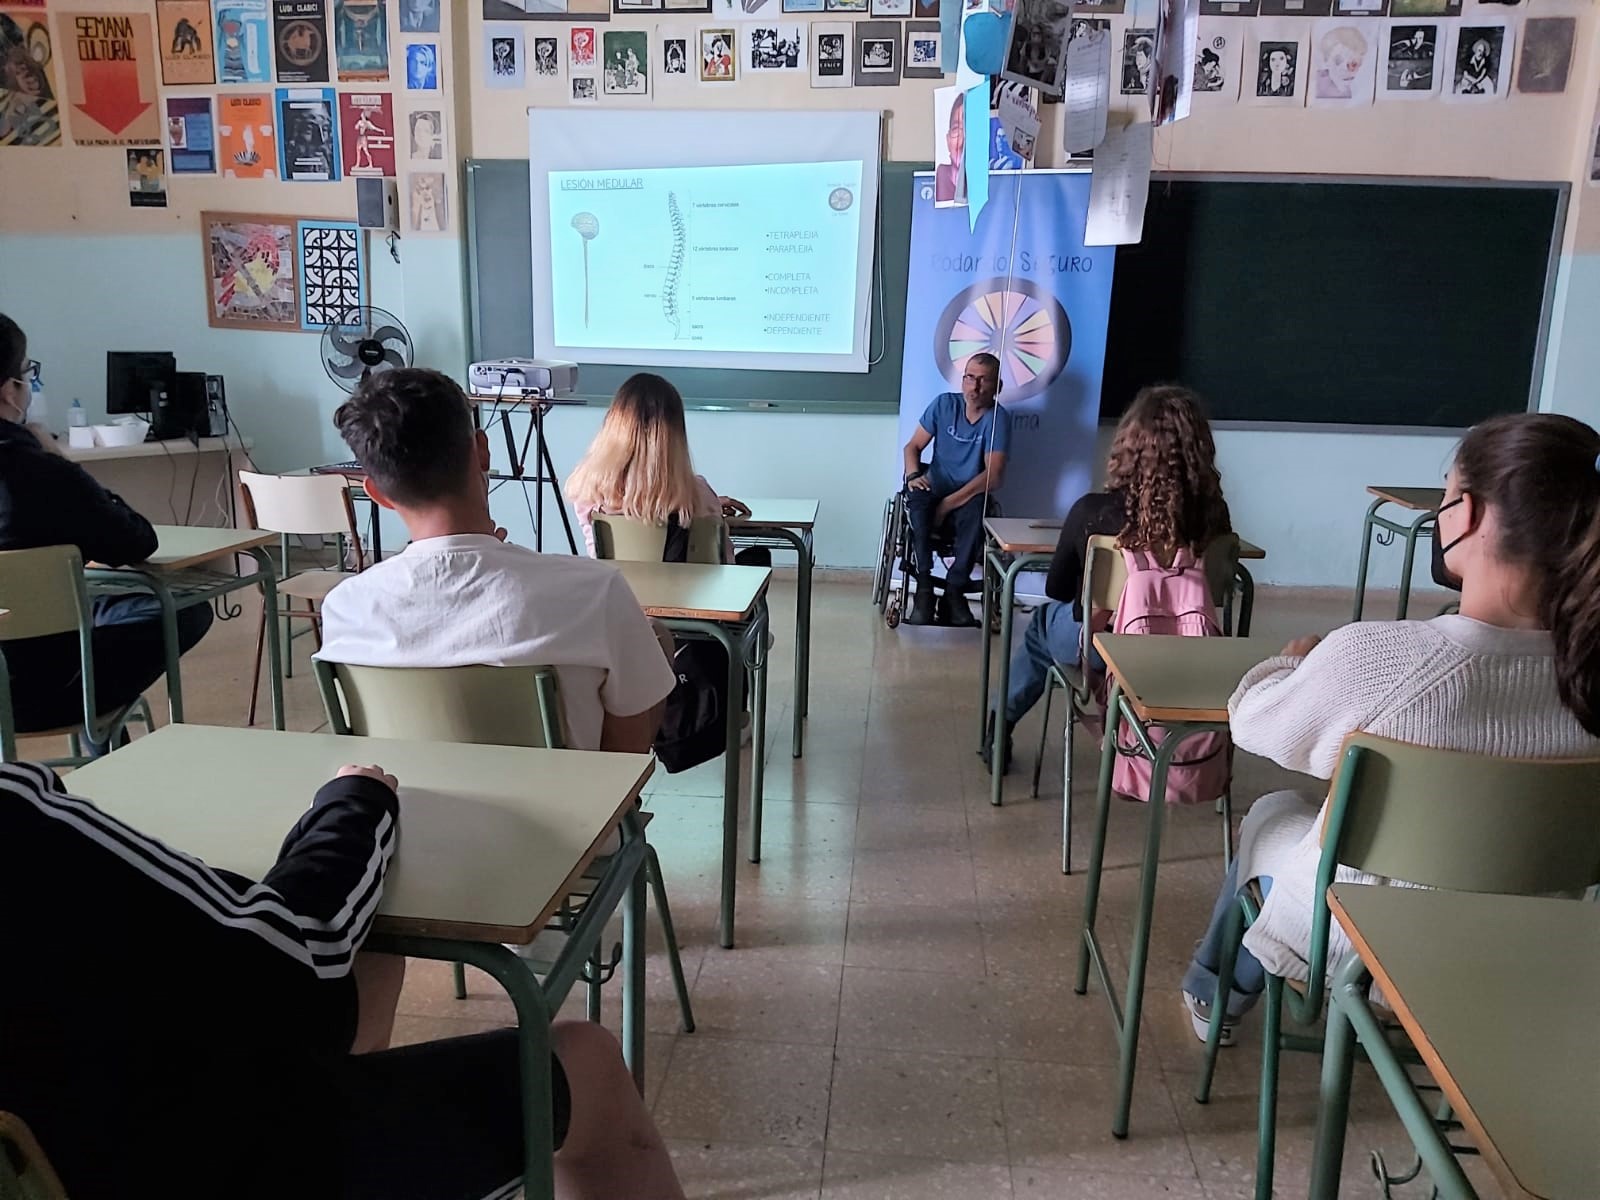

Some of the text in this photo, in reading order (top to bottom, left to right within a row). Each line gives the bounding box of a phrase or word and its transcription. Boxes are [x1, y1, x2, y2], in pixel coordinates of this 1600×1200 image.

[76, 16, 134, 38] SEMANA
[78, 39, 136, 61] CULTURAL
[597, 178, 643, 189] MEDULAR
[767, 272, 812, 281] COMPLETA
[767, 286, 819, 295] INCOMPLETA
[767, 313, 831, 322] INDEPENDIENTE
[766, 326, 823, 336] DEPENDIENTE
